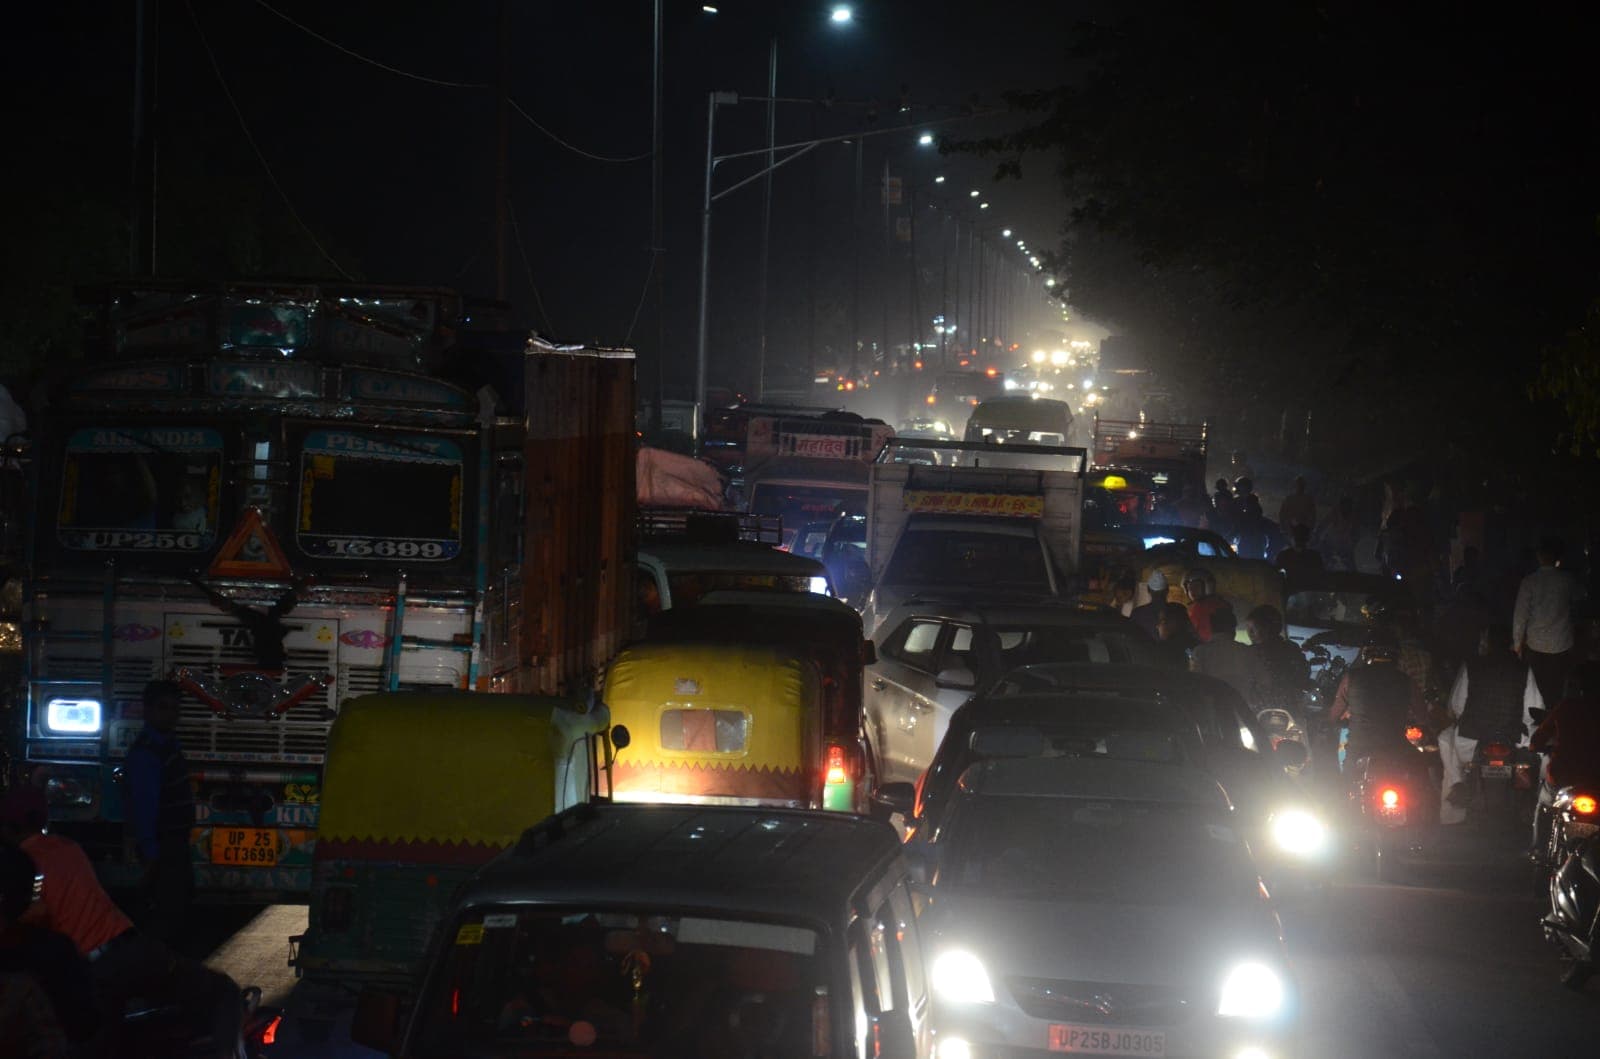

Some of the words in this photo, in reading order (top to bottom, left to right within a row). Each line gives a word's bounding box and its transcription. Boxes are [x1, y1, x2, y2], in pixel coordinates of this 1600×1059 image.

[219, 629, 252, 646] TA
[276, 806, 317, 823] KIN
[228, 831, 245, 846] UP
[254, 832, 271, 847] 25
[223, 847, 275, 862] CT3699
[1059, 1029, 1164, 1053] UP25BJ0305
